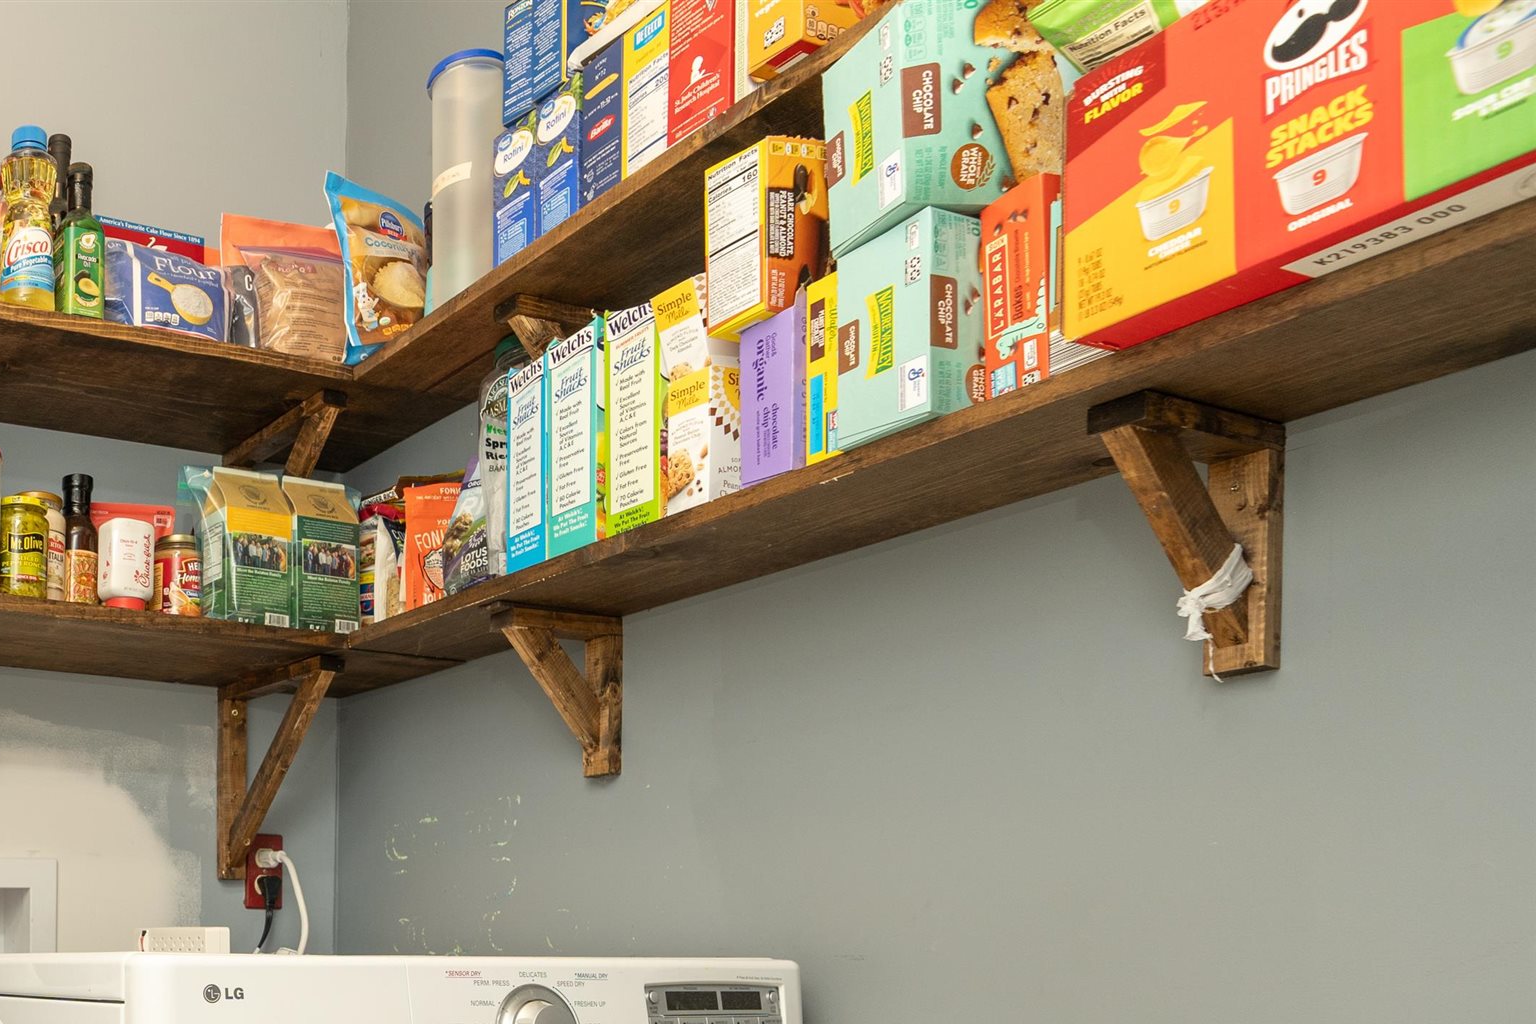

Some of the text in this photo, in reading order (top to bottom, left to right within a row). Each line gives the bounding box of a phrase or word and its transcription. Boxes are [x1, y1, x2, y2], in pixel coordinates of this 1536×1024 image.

[1069, 8, 1146, 53] Nutrition Facts
[654, 72, 669, 88] 200
[1083, 65, 1145, 107] BURSTING
[1266, 29, 1368, 115] PRINGLES
[674, 80, 721, 115] Research Hospital
[682, 91, 693, 103] Jude
[693, 72, 721, 94] Children's
[912, 88, 923, 113] CHIP
[921, 70, 934, 130] CHOCOLATE
[1084, 82, 1144, 125] FLAVOR
[1270, 83, 1369, 149] SNACK
[545, 110, 567, 132] Rotini
[590, 116, 614, 140] Barilla
[1266, 102, 1375, 169] STACKS
[502, 143, 524, 164] Rotini
[707, 147, 758, 182] Nutrition Facts
[959, 149, 970, 182] GRAIN
[967, 146, 979, 185] WHOLE
[741, 168, 759, 184] 160
[1312, 168, 1326, 186] 9
[708, 186, 733, 204] Calories
[787, 192, 795, 211] DARK
[1168, 200, 1180, 214] 9
[99, 215, 201, 244] America's Favorite Cake Flour Since 1894
[1287, 199, 1354, 232] ORIGINAL
[779, 226, 787, 257] ALMOND
[1312, 203, 1468, 267] K219383 000
[6, 238, 50, 269] Crisco
[77, 252, 98, 263] Avocado
[152, 253, 216, 282] Flour
[657, 292, 692, 316] Simple
[936, 299, 946, 325] CHIP
[945, 283, 954, 344] CHOCOLATE
[608, 303, 654, 336] Welch's
[550, 331, 593, 365] Welch's
[613, 346, 651, 375] Snacks
[620, 337, 646, 361] Fruit
[510, 360, 543, 394] Welch's
[560, 366, 583, 389] Fruit
[752, 338, 768, 402] organic
[554, 376, 588, 402] Snacks
[670, 379, 706, 402] Simple
[512, 403, 539, 430] Snacks
[517, 396, 536, 415] Fruit
[771, 402, 781, 450] chocolate
[619, 445, 648, 460] Preservative
[10, 535, 23, 551] Mt.
[23, 537, 43, 551] Olive
[460, 546, 488, 565] LOTUS
[460, 557, 489, 573] FOODS
[225, 987, 244, 1000] LG
